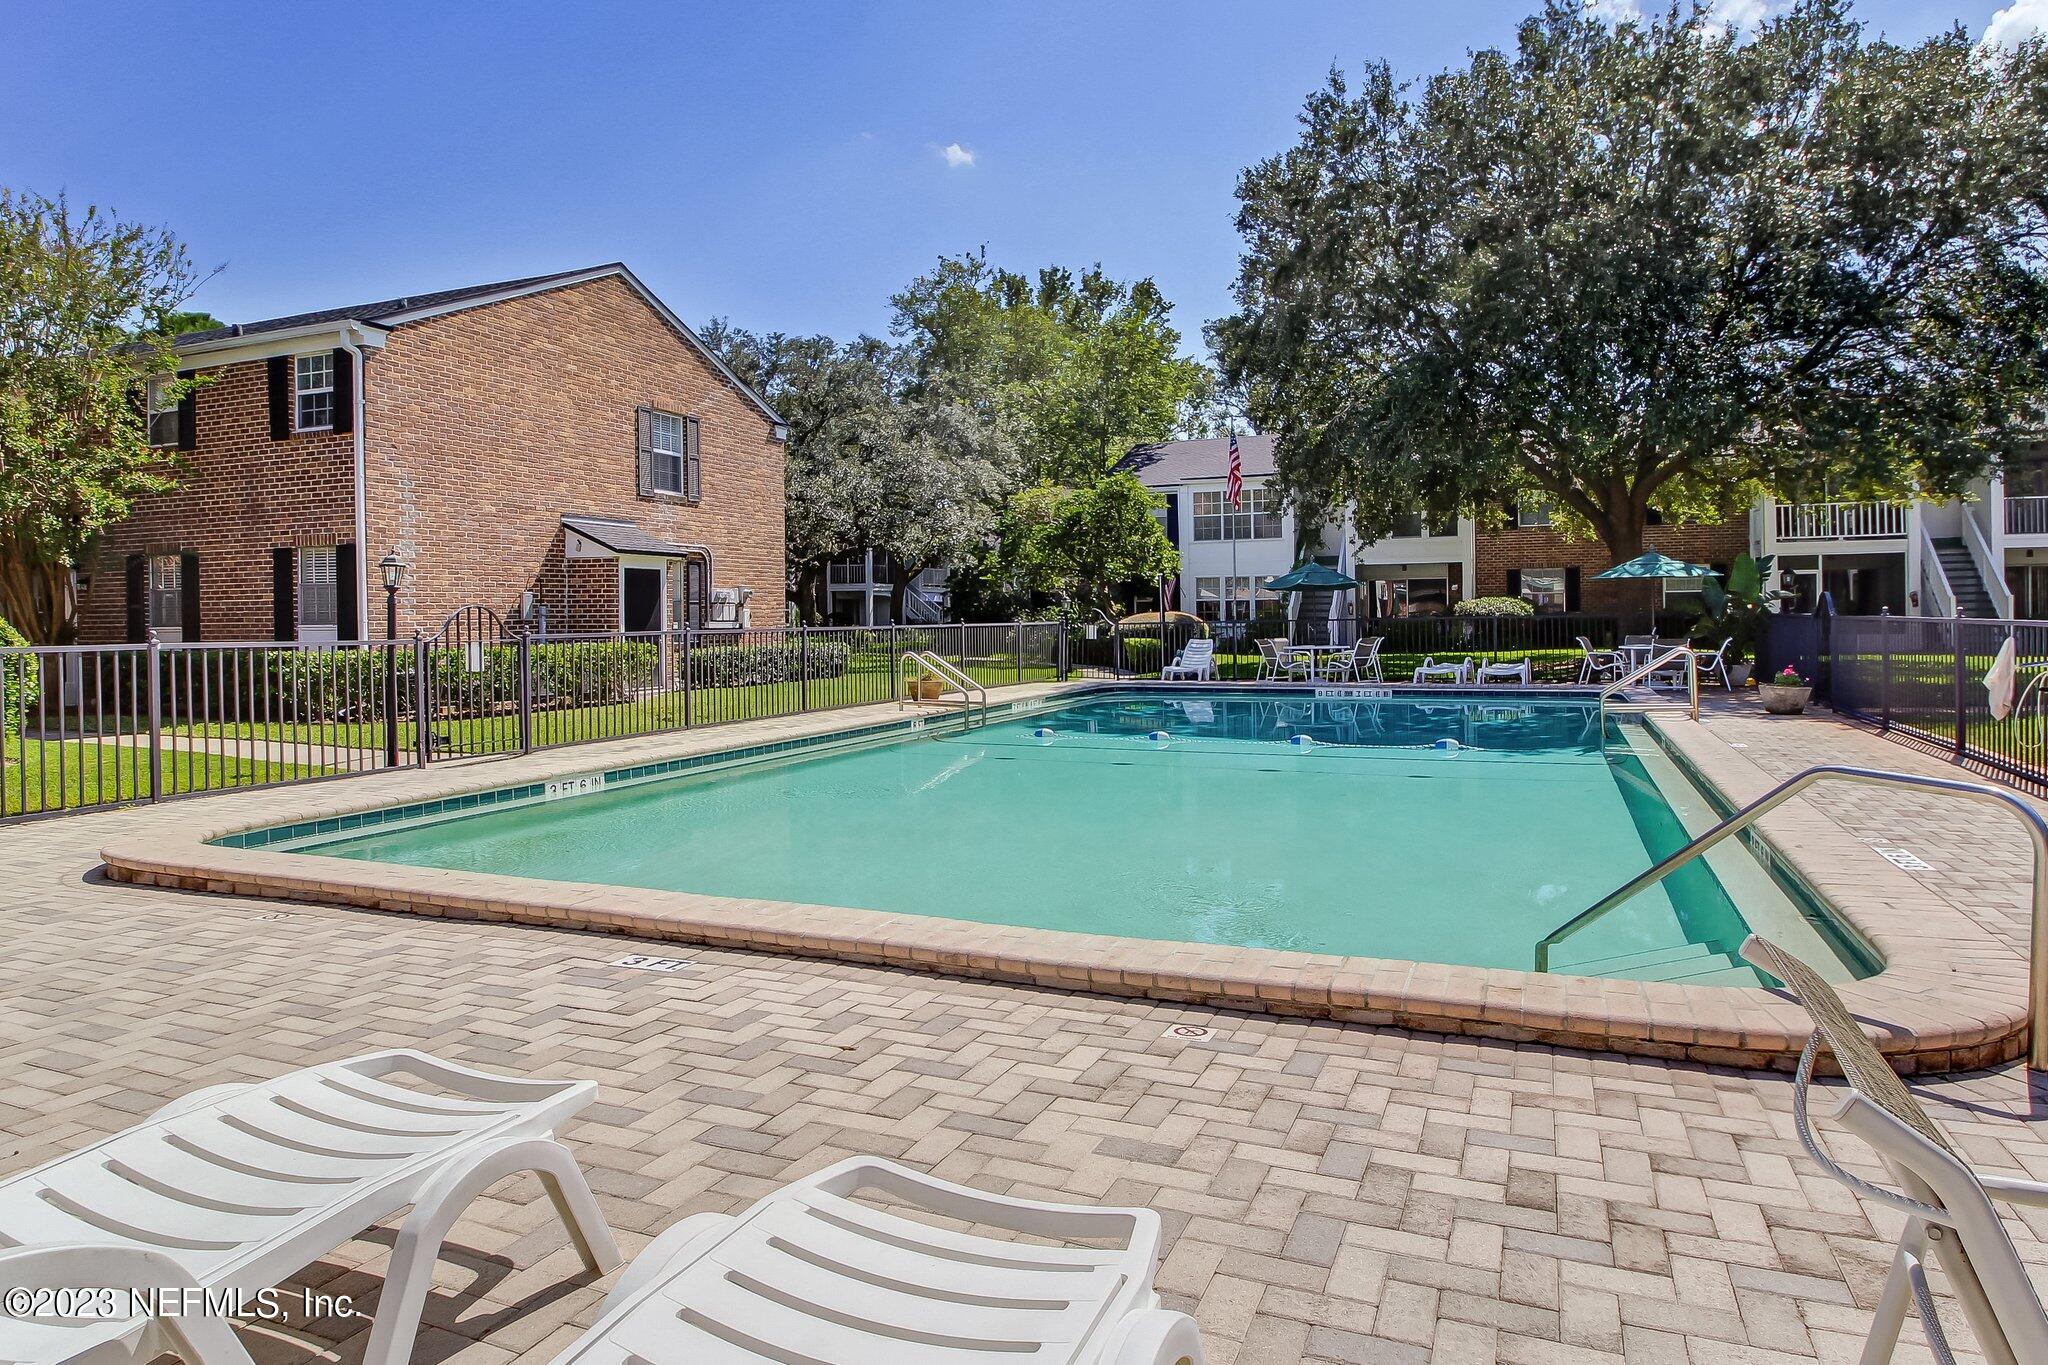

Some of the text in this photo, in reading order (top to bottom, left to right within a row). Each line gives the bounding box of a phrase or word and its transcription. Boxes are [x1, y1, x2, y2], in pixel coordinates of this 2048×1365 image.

[562, 781, 575, 793] FT
[591, 776, 602, 789] IN
[622, 957, 649, 965] 3
